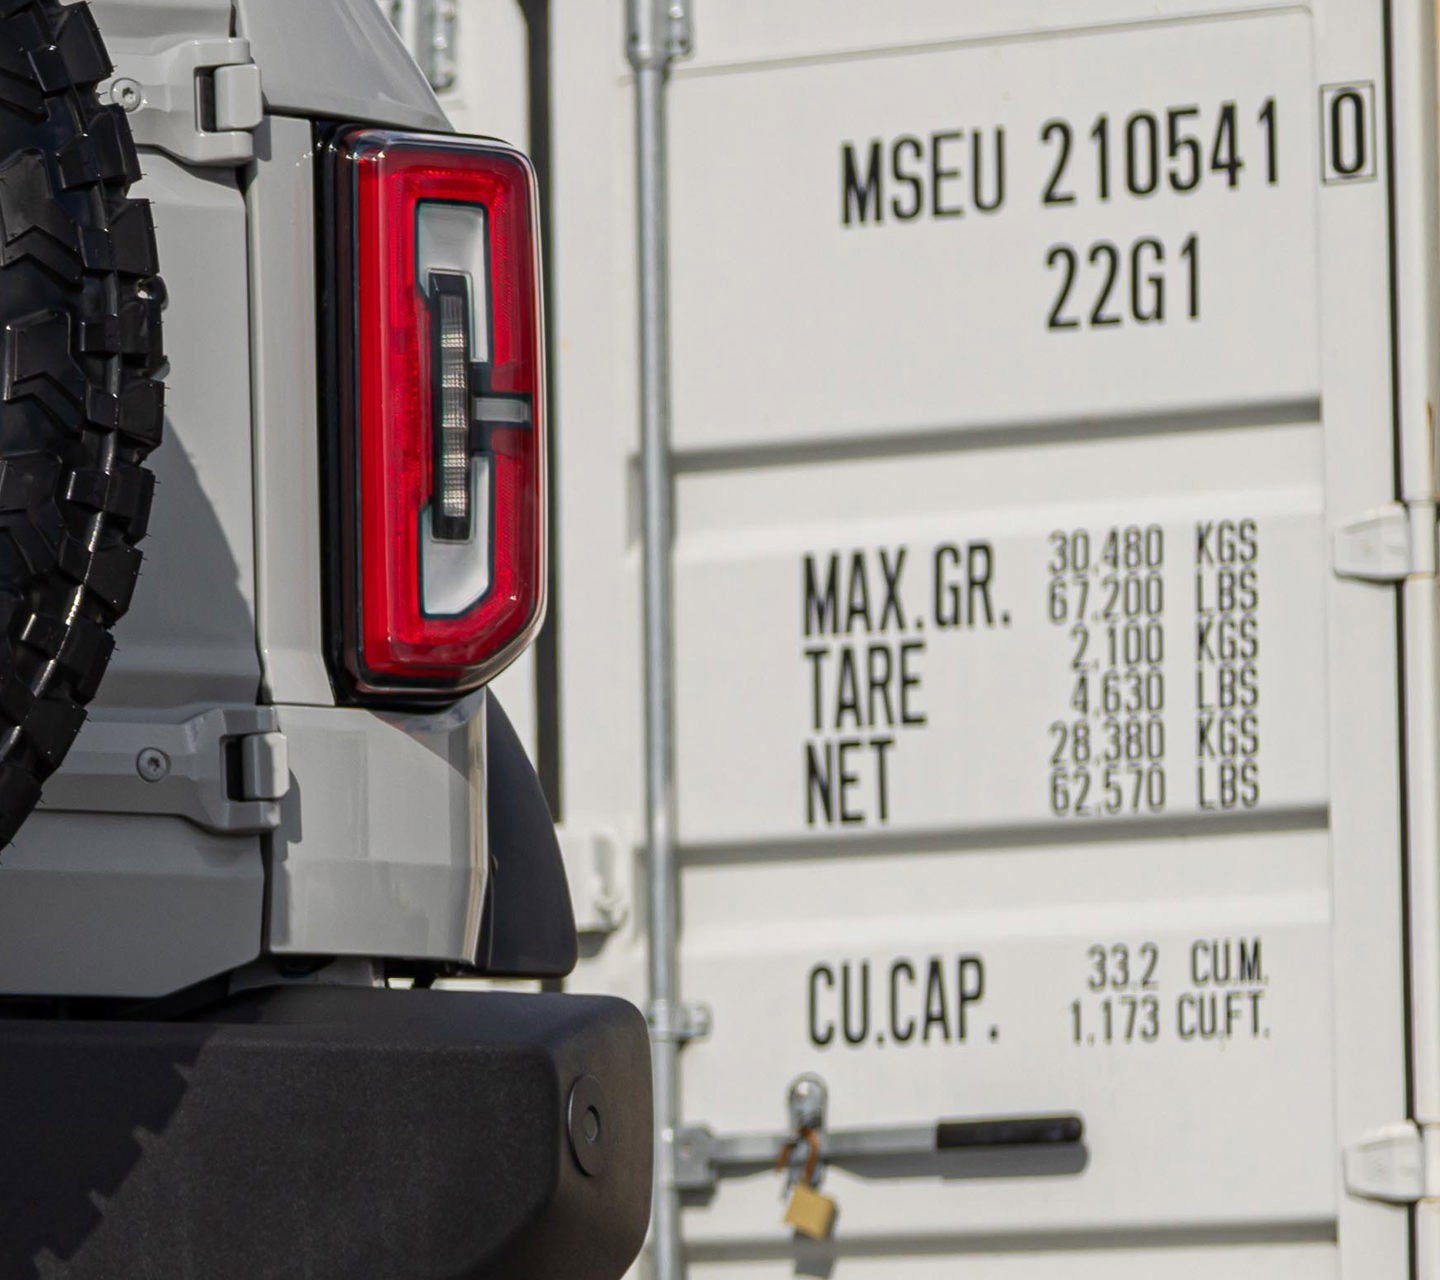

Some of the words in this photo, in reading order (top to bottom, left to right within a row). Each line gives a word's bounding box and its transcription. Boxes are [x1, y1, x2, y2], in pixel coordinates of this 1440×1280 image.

[840, 125, 1005, 228] MSEU
[1040, 96, 1280, 207] 210541
[1330, 86, 1367, 180] 0
[1045, 231, 1200, 332] 22G1
[802, 540, 1011, 637] MAX.GR.
[1195, 518, 1259, 566] KGS
[1195, 568, 1259, 615] LBS
[802, 639, 928, 731] TARE
[1195, 615, 1259, 665] KGS
[1195, 664, 1260, 712] LBS
[804, 737, 896, 828] NET
[1196, 712, 1260, 760] KGS
[1197, 760, 1260, 809] LBS
[807, 953, 1000, 1049] CU.CAP.
